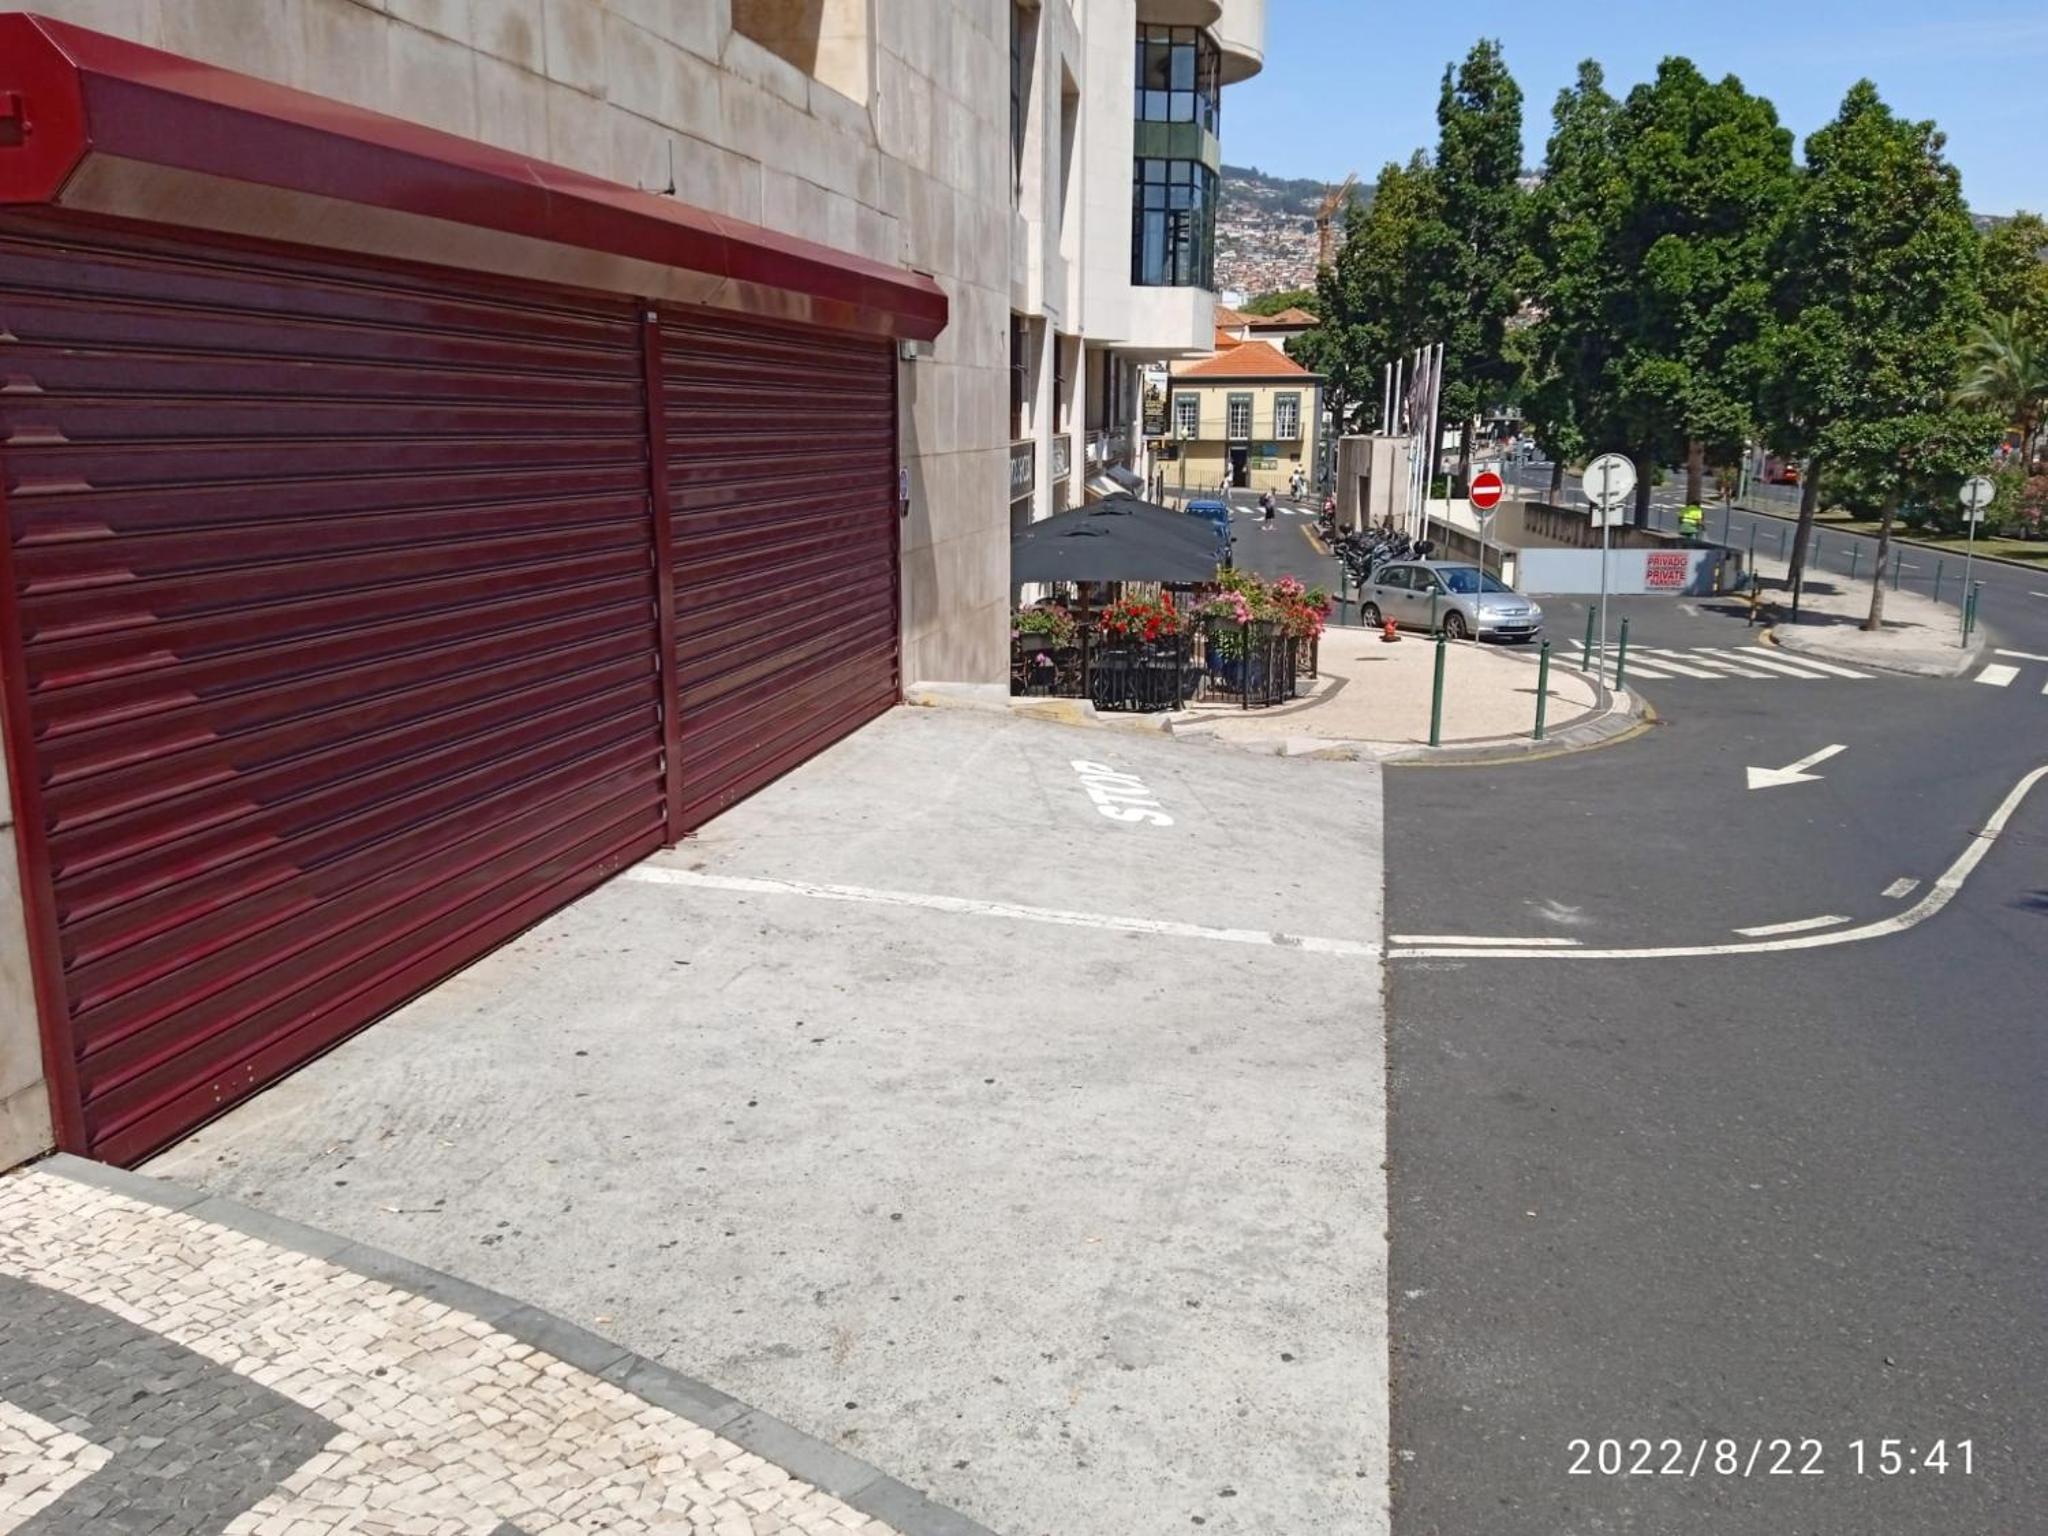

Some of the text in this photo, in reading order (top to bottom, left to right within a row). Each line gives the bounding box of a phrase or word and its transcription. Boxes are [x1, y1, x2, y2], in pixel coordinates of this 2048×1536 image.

[1648, 557, 1689, 566] PRIVADO
[1646, 570, 1687, 580] PRIVATE
[1070, 760, 1175, 827] STOP
